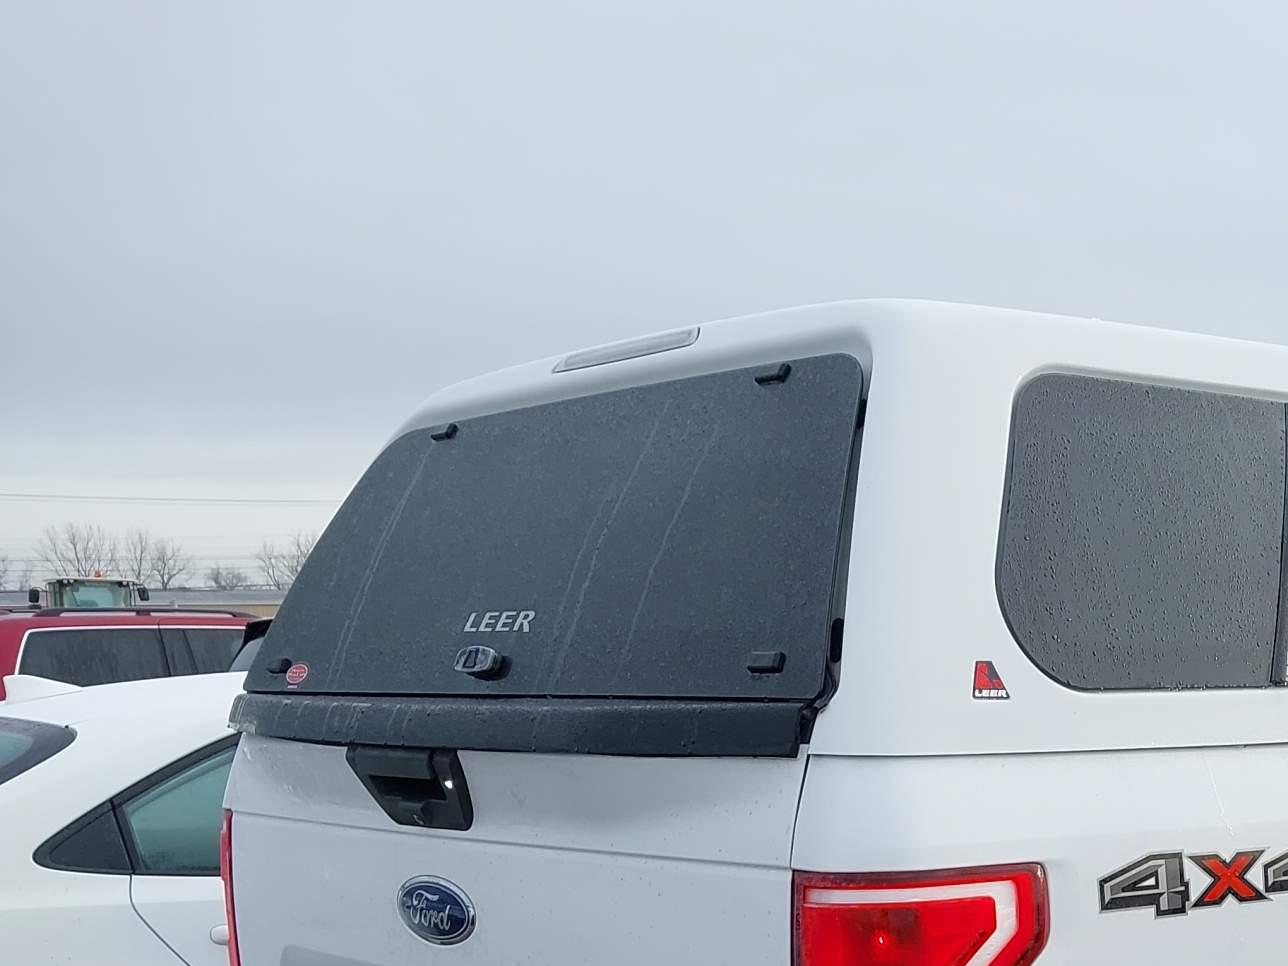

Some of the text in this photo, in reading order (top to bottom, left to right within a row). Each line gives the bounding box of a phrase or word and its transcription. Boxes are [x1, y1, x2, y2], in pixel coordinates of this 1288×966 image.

[463, 610, 536, 633] LEER
[975, 689, 1008, 698] LEER
[410, 889, 451, 931] Ford
